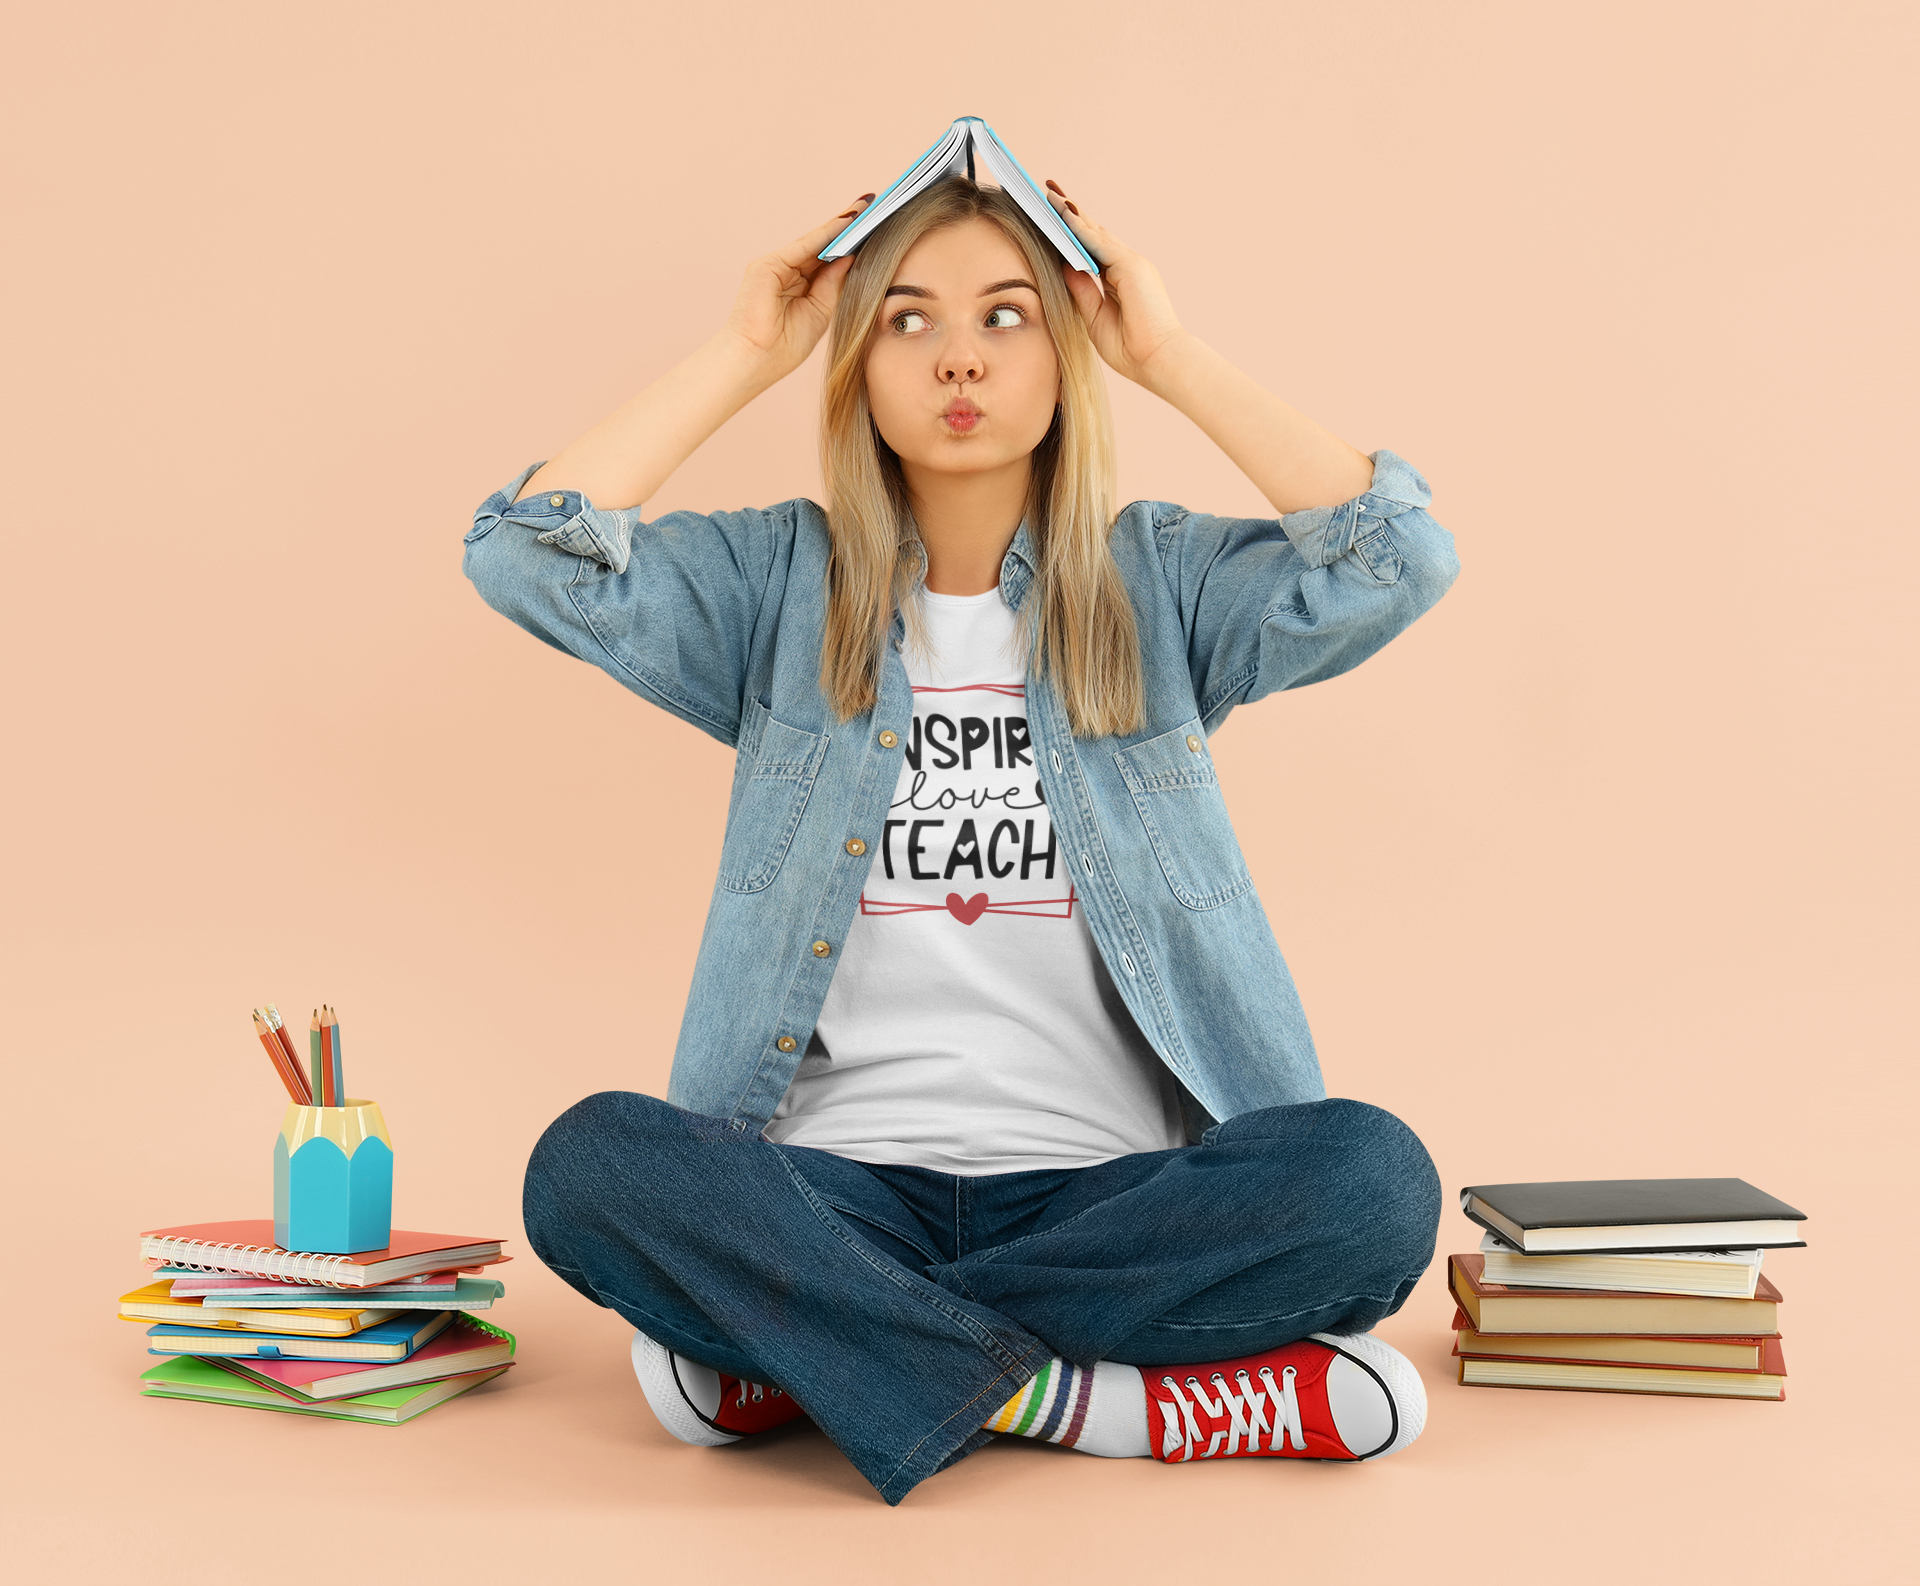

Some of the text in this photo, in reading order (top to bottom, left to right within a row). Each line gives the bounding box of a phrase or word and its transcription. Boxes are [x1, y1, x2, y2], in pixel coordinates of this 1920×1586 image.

[906, 714, 1033, 770] NSPIR
[891, 771, 1045, 810] love
[883, 819, 1056, 880] TEACH
